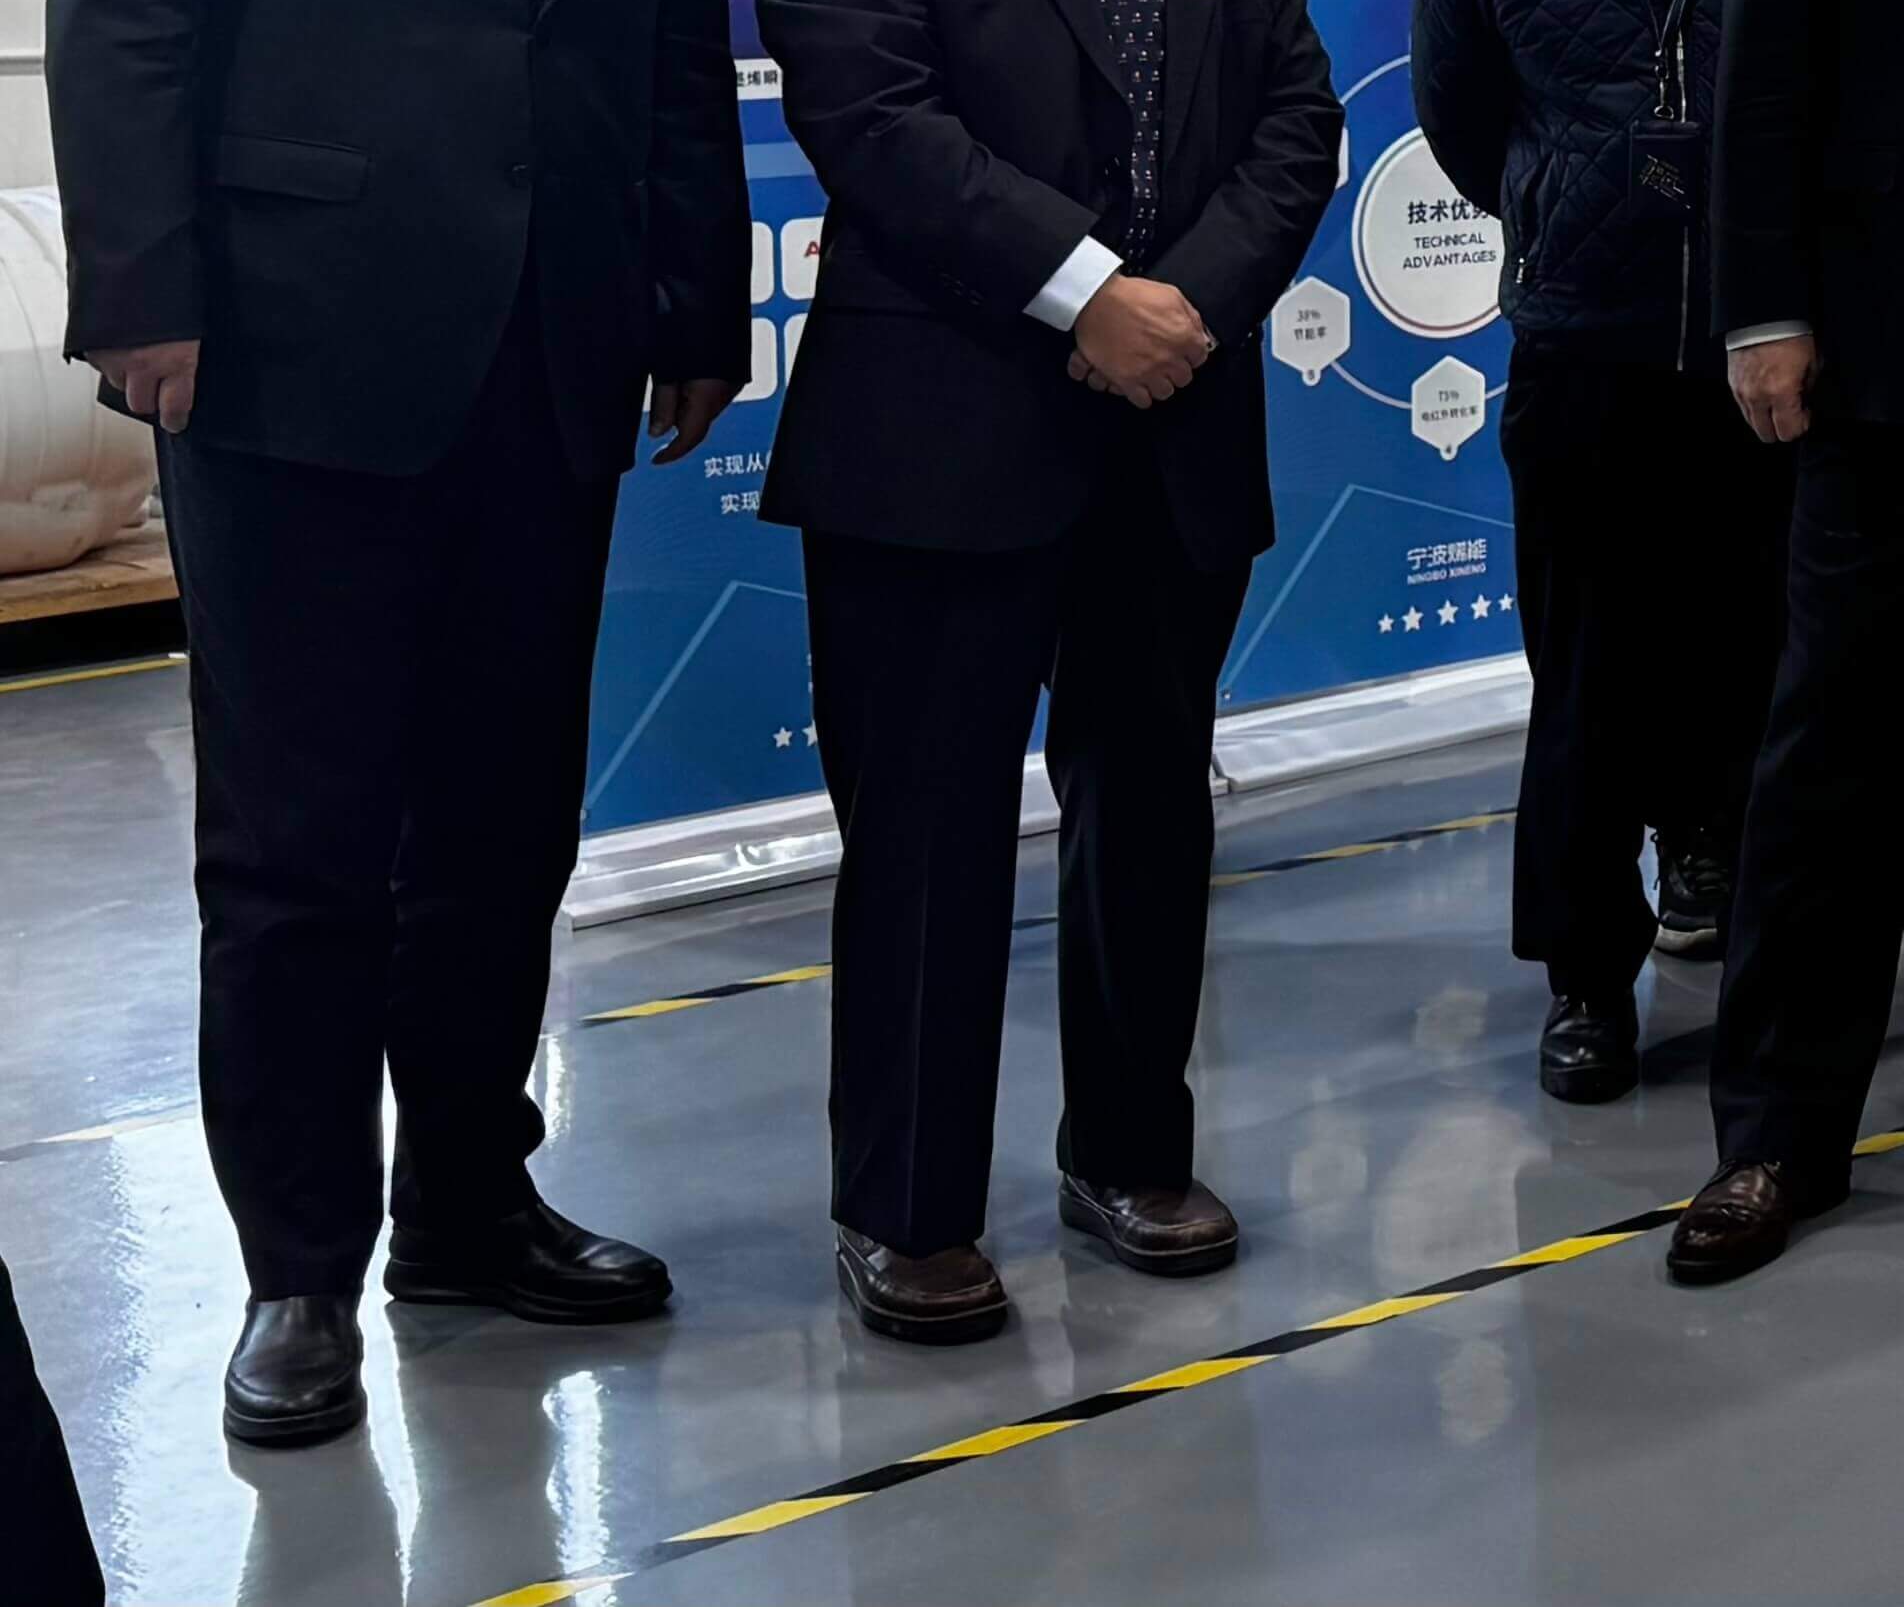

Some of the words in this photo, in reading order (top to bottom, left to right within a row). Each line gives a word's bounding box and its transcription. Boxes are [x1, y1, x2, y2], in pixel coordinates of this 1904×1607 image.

[1414, 232, 1486, 250] TECHNICAL
[1403, 250, 1497, 270] ADVANTAGES
[704, 450, 772, 479] 实现从
